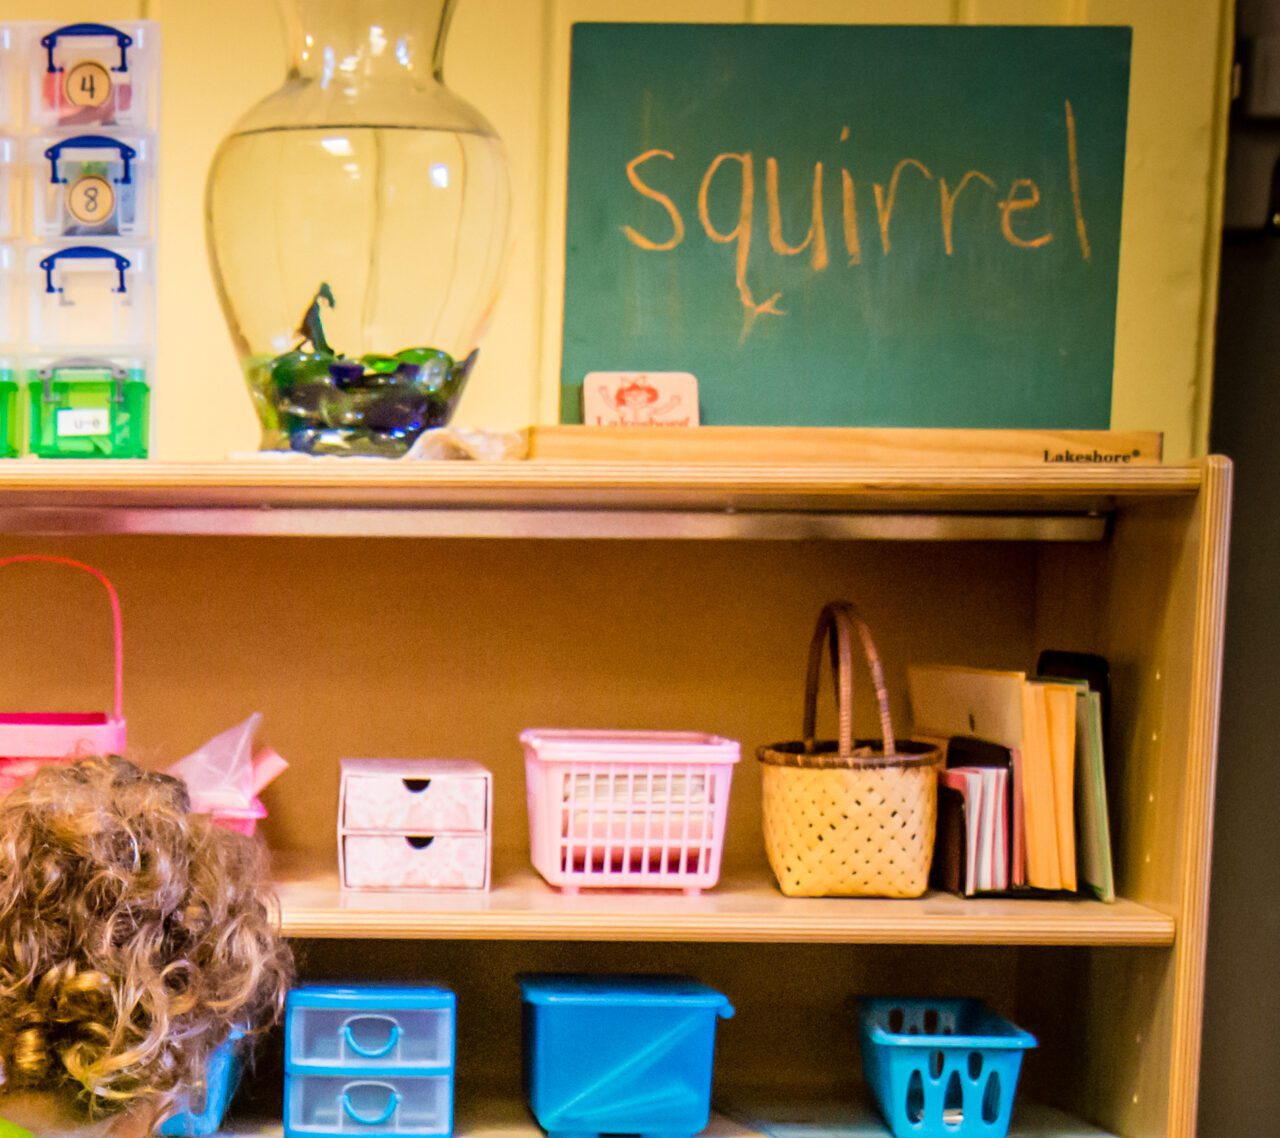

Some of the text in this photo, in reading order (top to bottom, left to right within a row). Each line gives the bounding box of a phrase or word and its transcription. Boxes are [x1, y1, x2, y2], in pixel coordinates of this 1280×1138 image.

[80, 73, 96, 100] 4
[83, 187, 99, 213] 8
[620, 98, 1093, 318] squirrel
